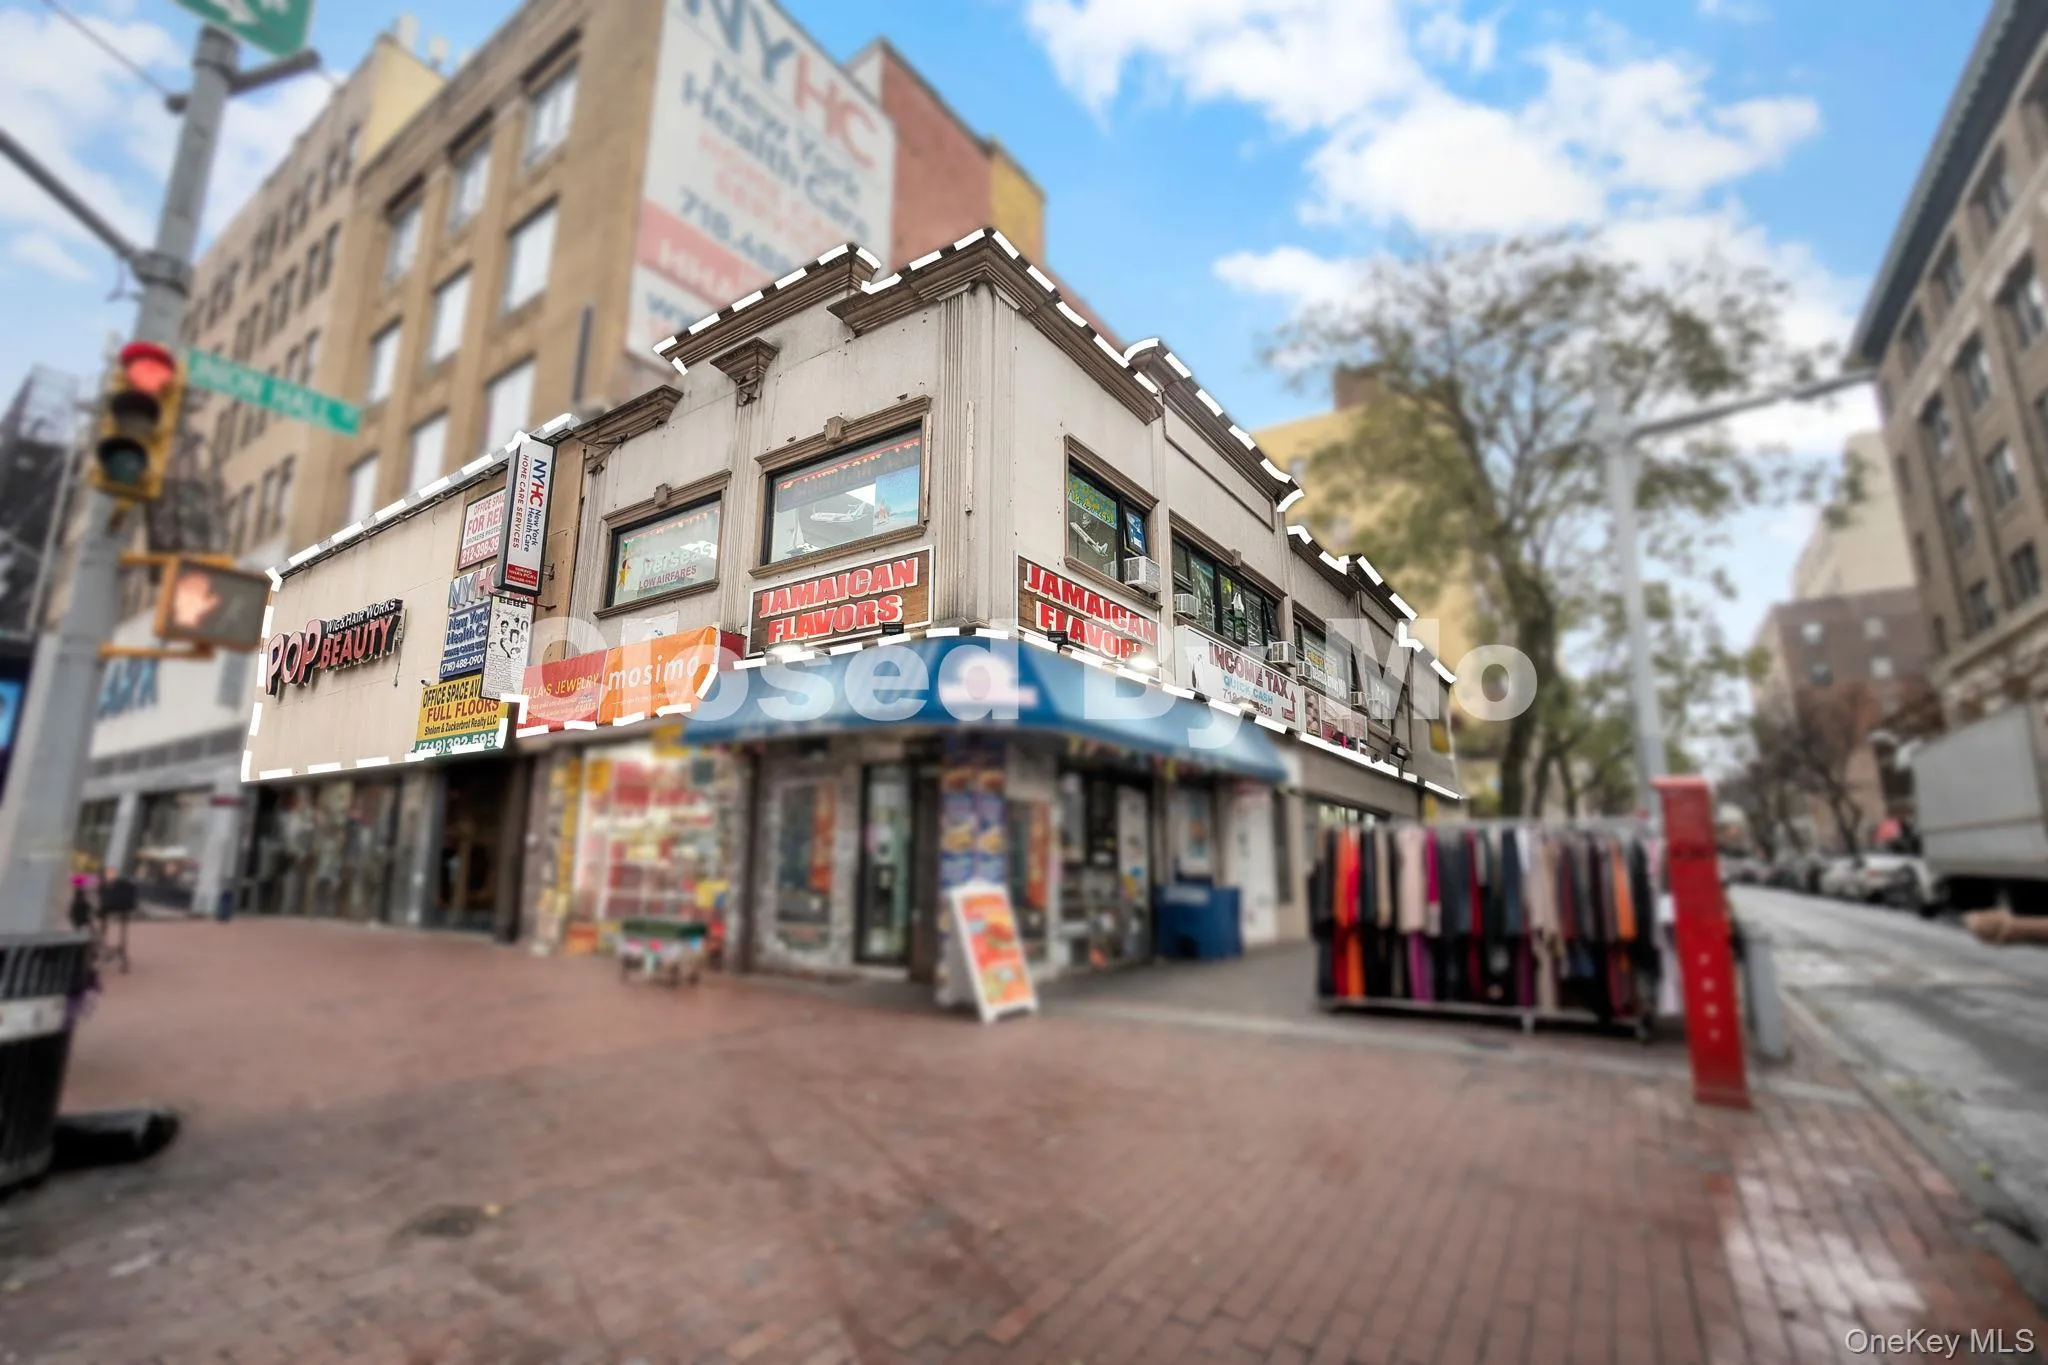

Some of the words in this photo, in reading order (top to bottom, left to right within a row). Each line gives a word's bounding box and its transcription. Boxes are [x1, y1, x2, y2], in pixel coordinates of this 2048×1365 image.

[681, 70, 800, 190] Health
[520, 454, 529, 480] HOME
[517, 481, 526, 505] CARE
[529, 458, 547, 508] NYHC
[466, 513, 485, 538] FOR
[512, 507, 523, 549] SERVICES
[525, 507, 535, 534] Health
[533, 509, 541, 528] New
[523, 533, 532, 552] Care
[531, 528, 540, 547] York
[759, 557, 918, 618] JAMAICAN
[366, 599, 396, 619] WORKS
[1024, 562, 1155, 646] JAMAICAN
[448, 616, 469, 632] New
[768, 594, 903, 644] FLAVORS
[446, 625, 474, 646] Health
[266, 619, 322, 694] POP
[320, 614, 396, 670] BEAUTY
[441, 661, 456, 674] (718)
[608, 655, 700, 692] mosimo
[1208, 641, 1263, 688] INCOME
[1265, 669, 1289, 700] TAX
[423, 684, 446, 708] OFFICE
[447, 680, 468, 704] SPACE
[556, 672, 600, 695] JEWELRY
[1223, 674, 1252, 695] QUICK
[1252, 688, 1274, 705] CASH
[427, 704, 452, 723] FULL
[455, 699, 499, 718] FLOORS
[471, 716, 486, 730] Realty
[487, 714, 498, 725] LLC
